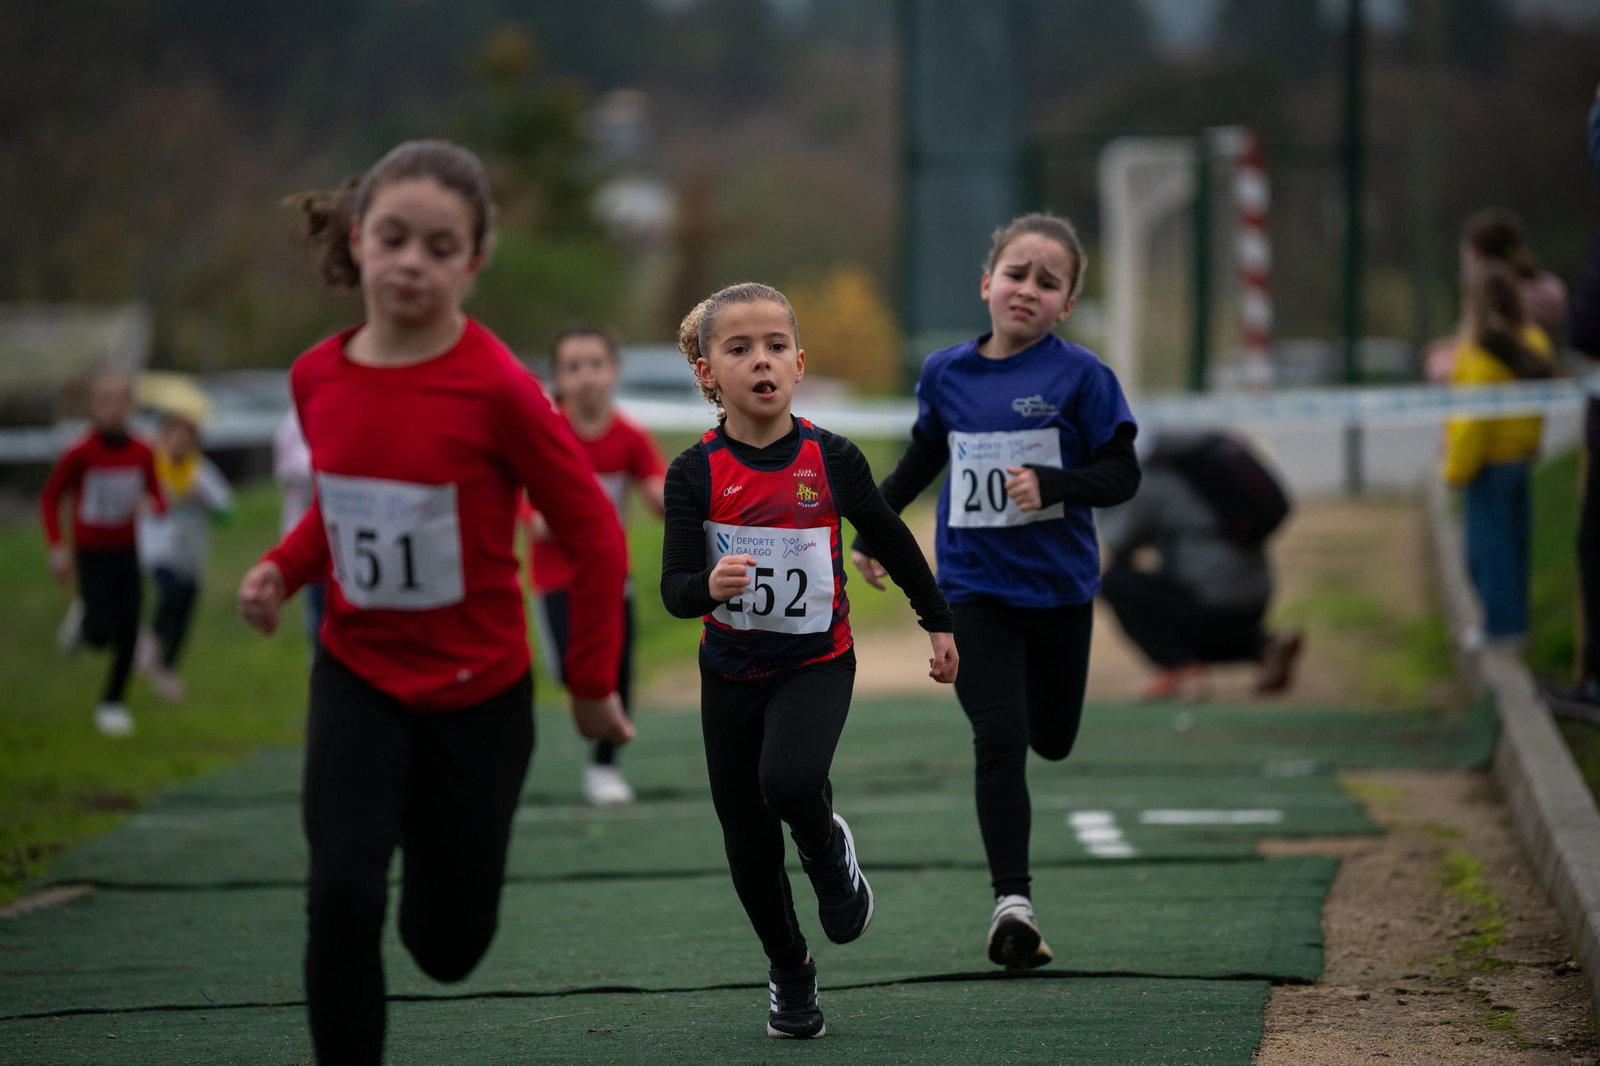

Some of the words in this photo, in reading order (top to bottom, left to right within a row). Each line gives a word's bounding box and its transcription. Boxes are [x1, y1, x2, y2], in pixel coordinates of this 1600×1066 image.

[736, 537, 775, 546] DEPORTE
[736, 547, 771, 556] GALEGO
[726, 567, 808, 617] 52
